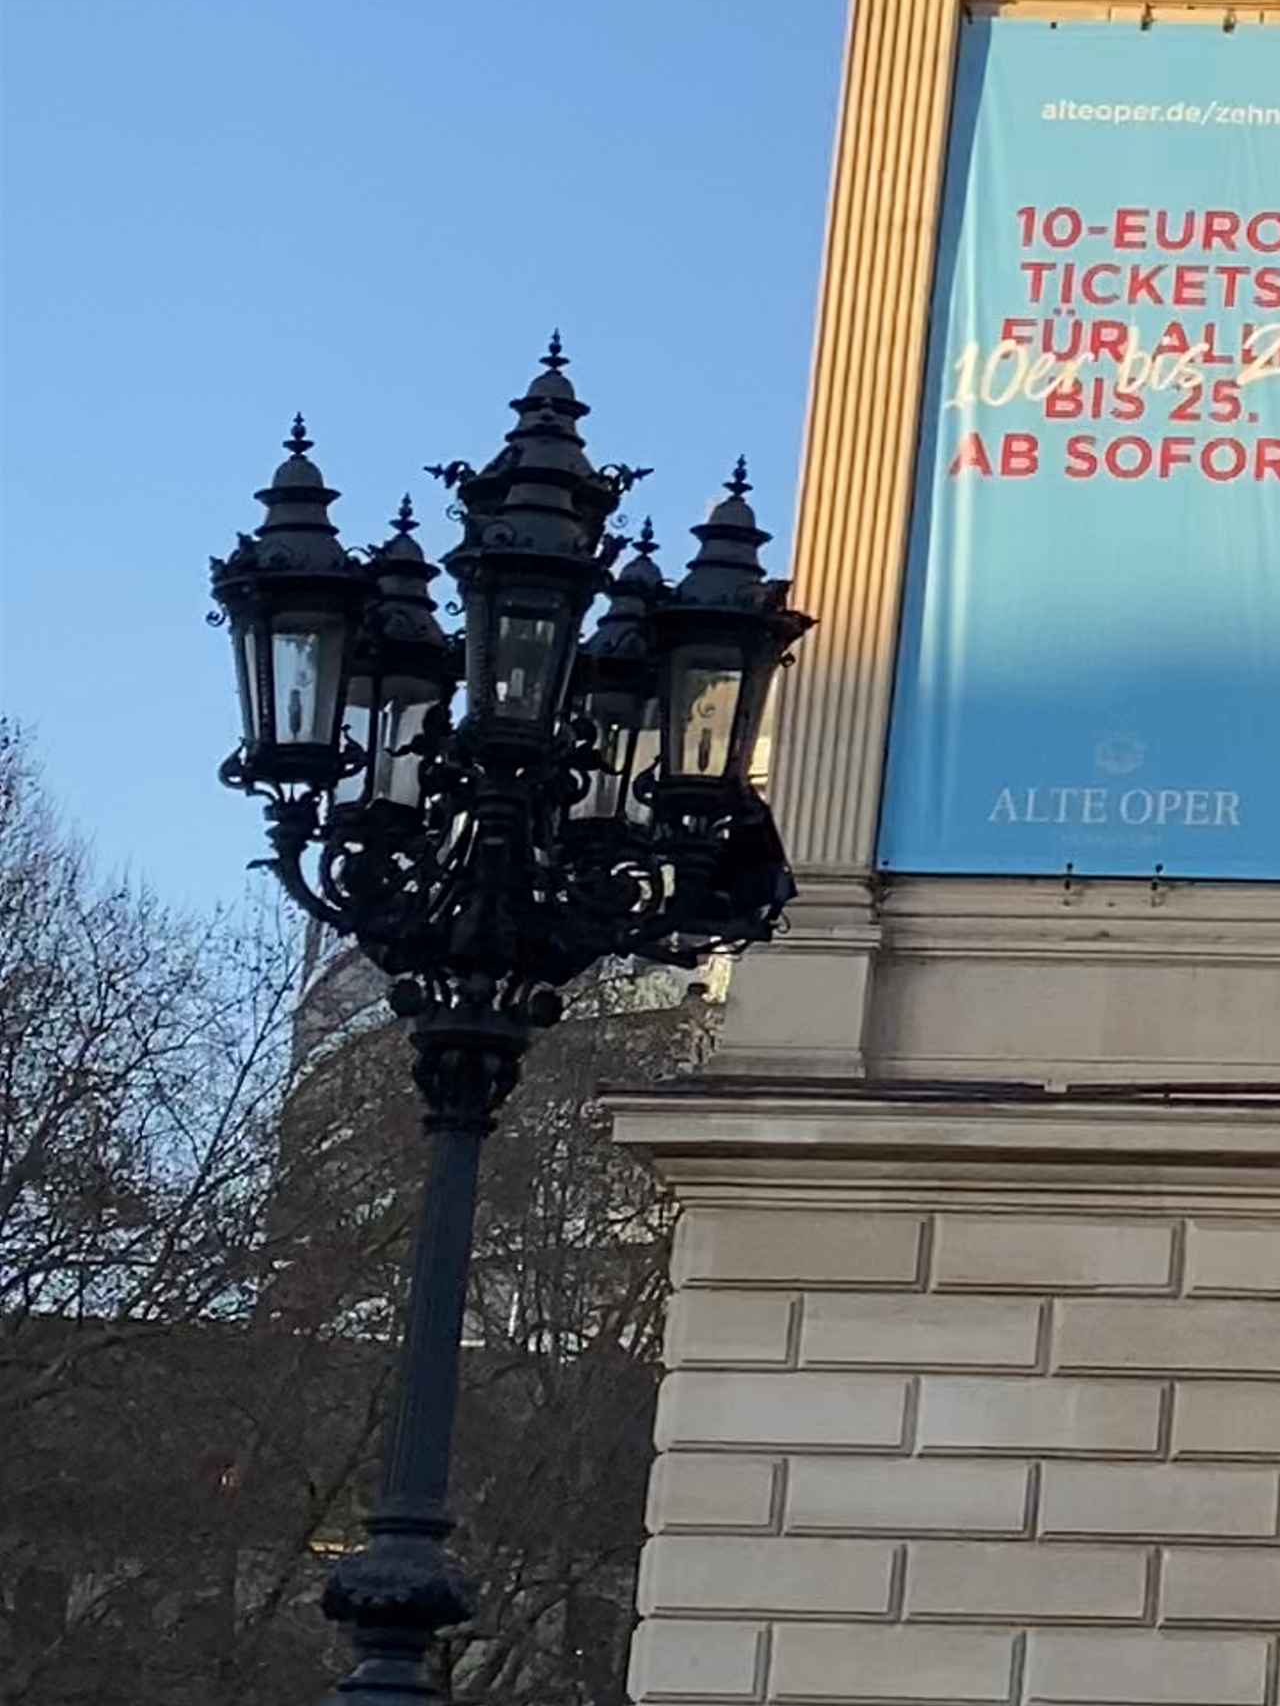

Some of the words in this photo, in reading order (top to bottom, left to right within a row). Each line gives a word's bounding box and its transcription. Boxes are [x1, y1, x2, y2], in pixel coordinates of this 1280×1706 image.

[1000, 308, 1128, 363] FÜR
[1045, 377, 1146, 422] BIS
[1168, 379, 1259, 423] 25.
[948, 432, 1039, 478] AB
[987, 787, 1107, 823] ALTE
[1119, 789, 1240, 826] OPER
